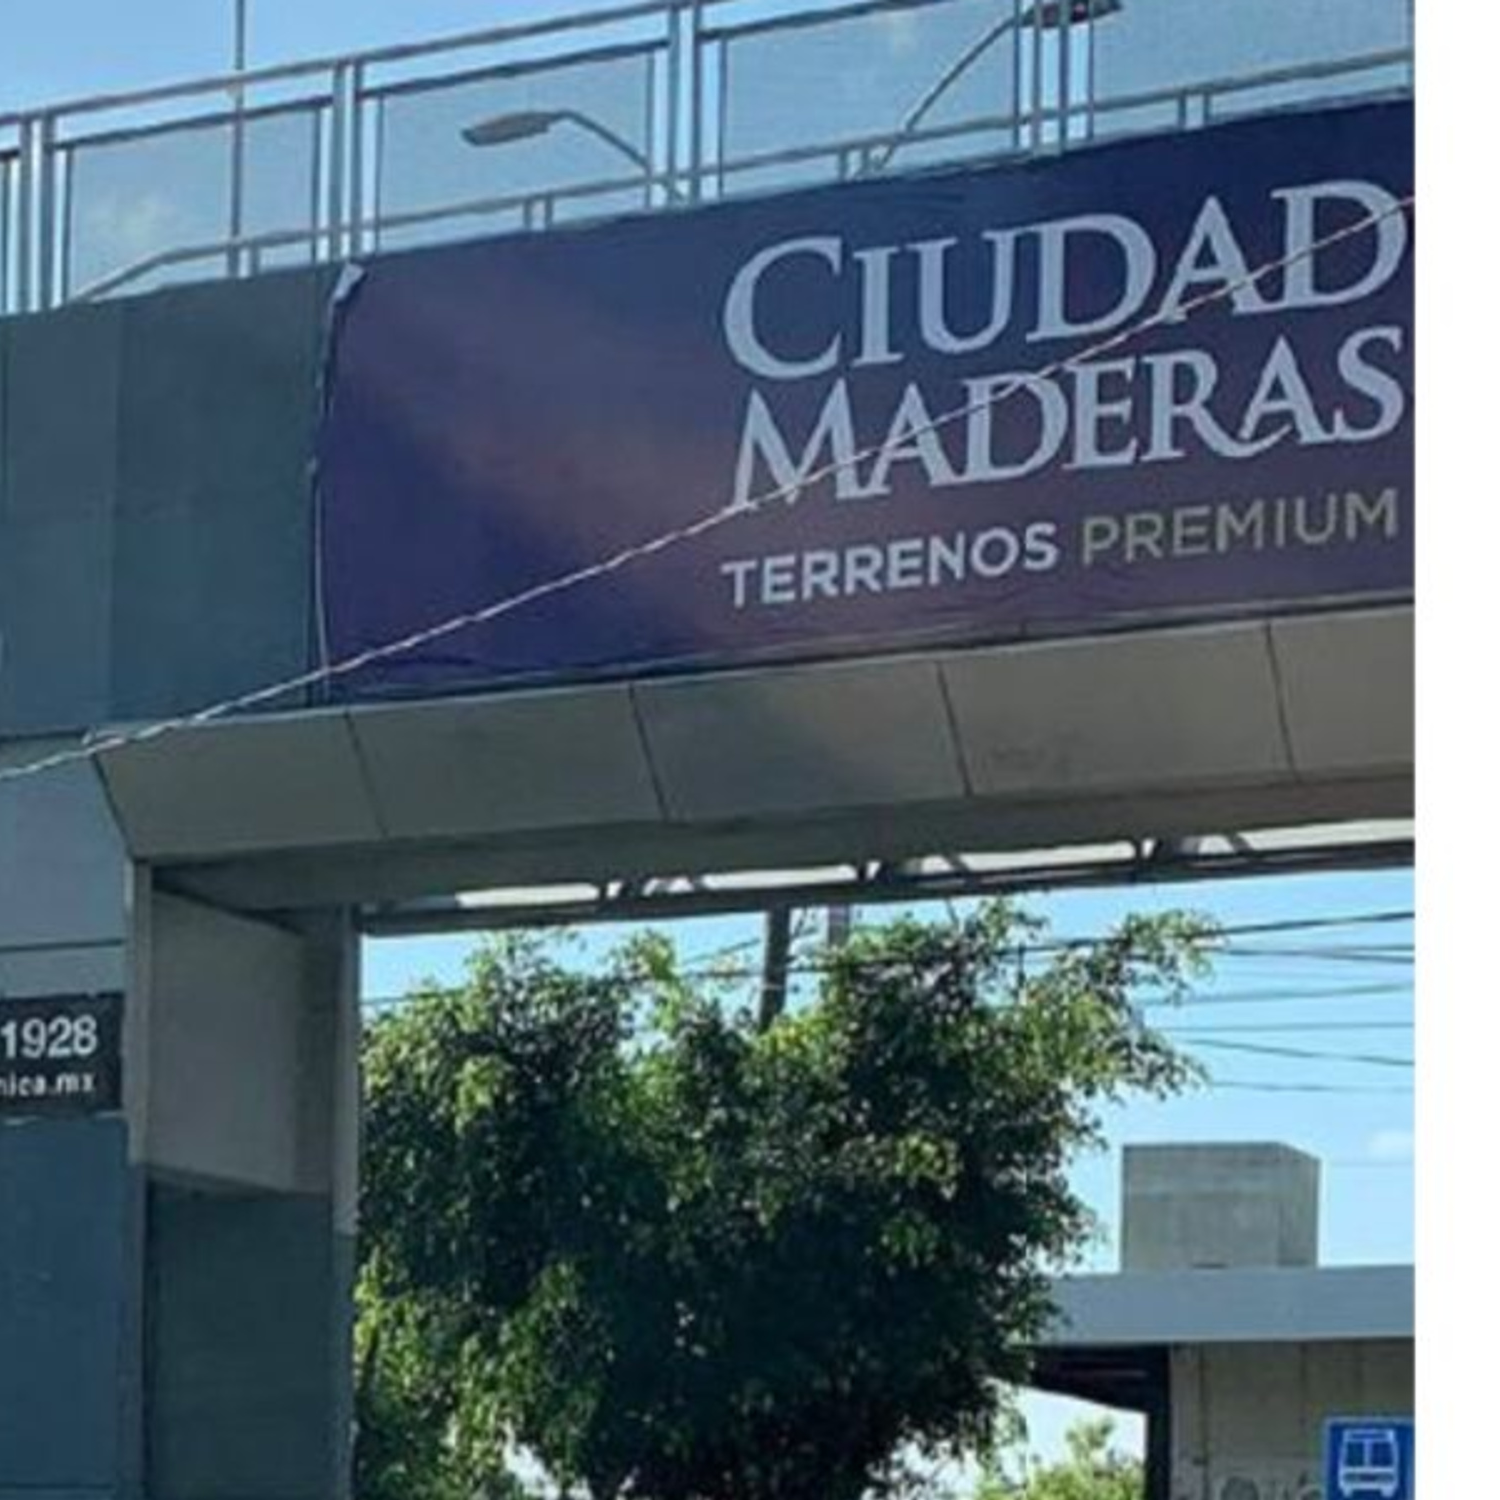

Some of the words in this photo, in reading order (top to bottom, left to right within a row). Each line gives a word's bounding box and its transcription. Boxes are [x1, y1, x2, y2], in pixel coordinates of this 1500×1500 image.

[723, 179, 1407, 380] CIUDAD
[727, 327, 1404, 514] MADERAS
[721, 523, 1059, 608] TERRENOS
[1082, 488, 1398, 567] PREMIUM
